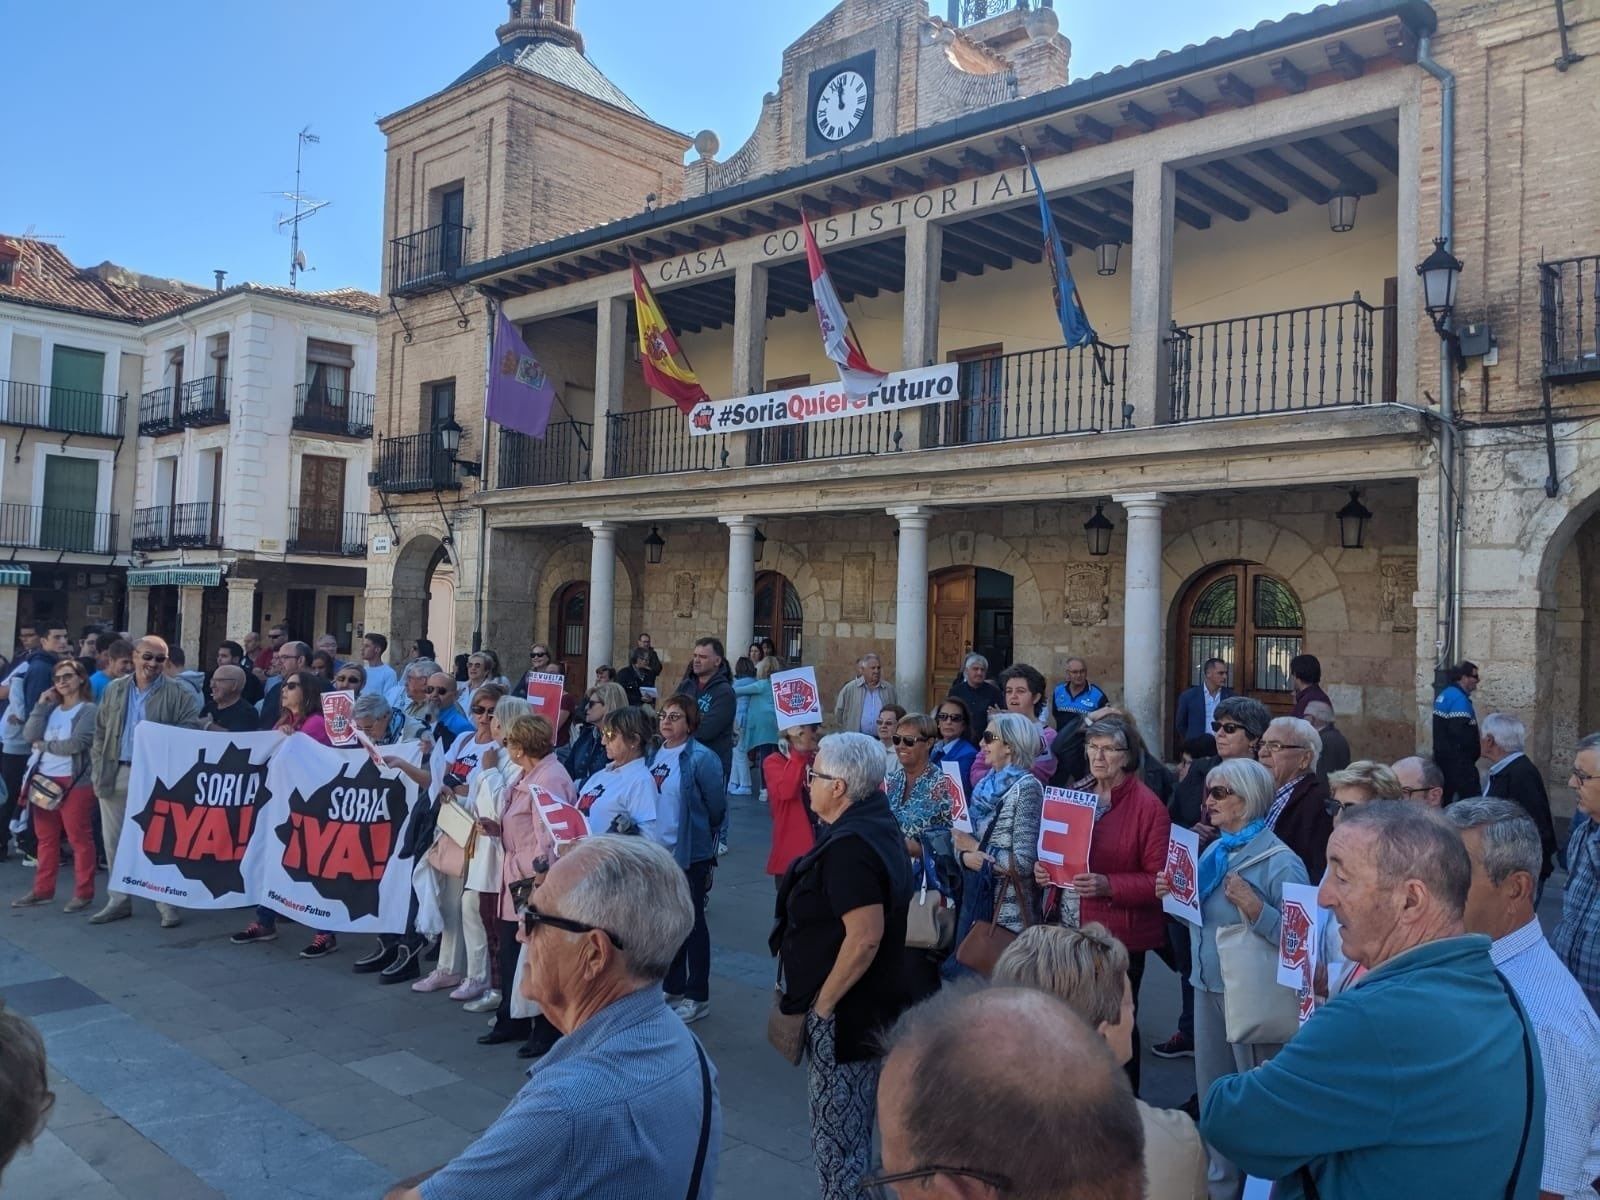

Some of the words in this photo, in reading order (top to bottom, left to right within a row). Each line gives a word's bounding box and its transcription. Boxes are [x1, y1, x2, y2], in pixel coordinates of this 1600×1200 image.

[660, 248, 727, 282] CASA
[195, 772, 260, 806] SORIA
[328, 786, 391, 822] SORIA
[1046, 787, 1097, 804] REVUELTA
[143, 799, 254, 861] ¡YA!
[283, 812, 392, 880] ¡YA!
